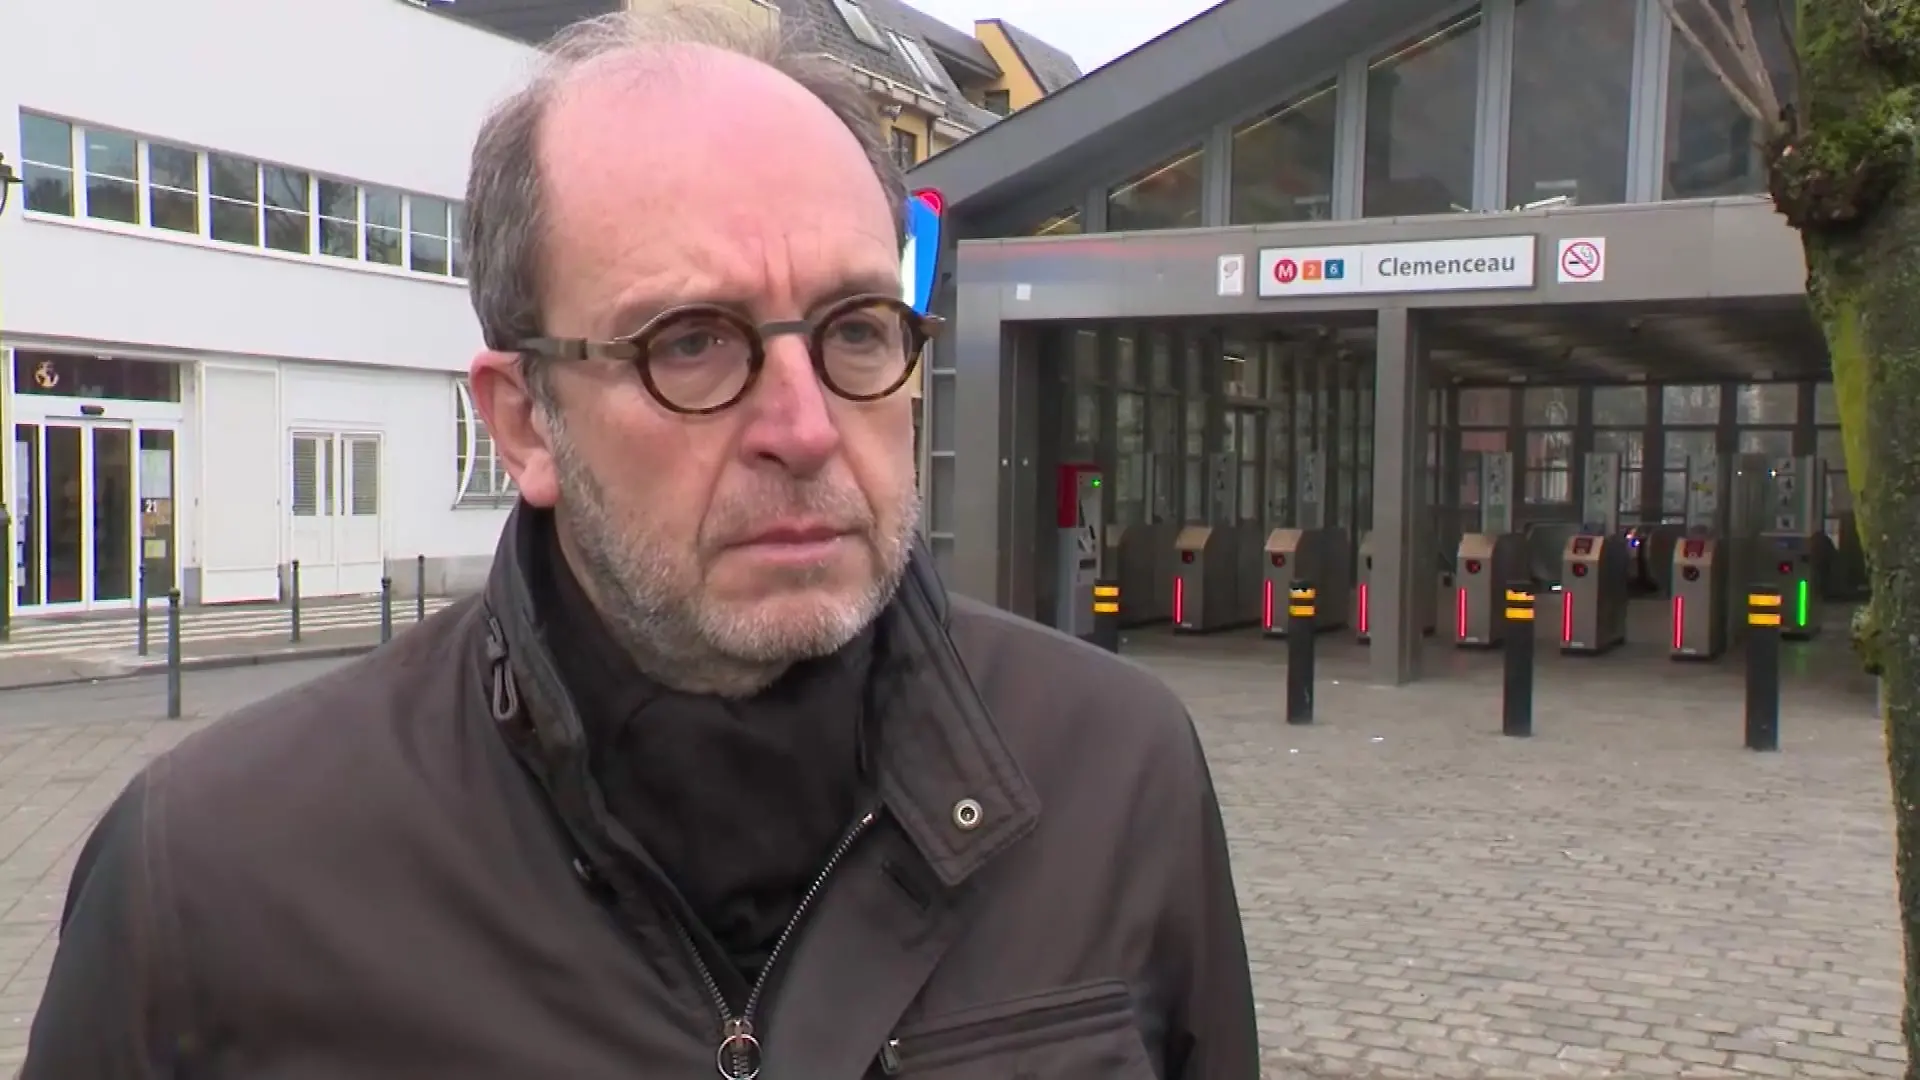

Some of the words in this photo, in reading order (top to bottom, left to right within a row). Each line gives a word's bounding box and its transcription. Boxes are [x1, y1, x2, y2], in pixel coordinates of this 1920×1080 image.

[1278, 263, 1294, 279] M
[1377, 256, 1516, 277] Clemenceau
[145, 499, 157, 513] 21
